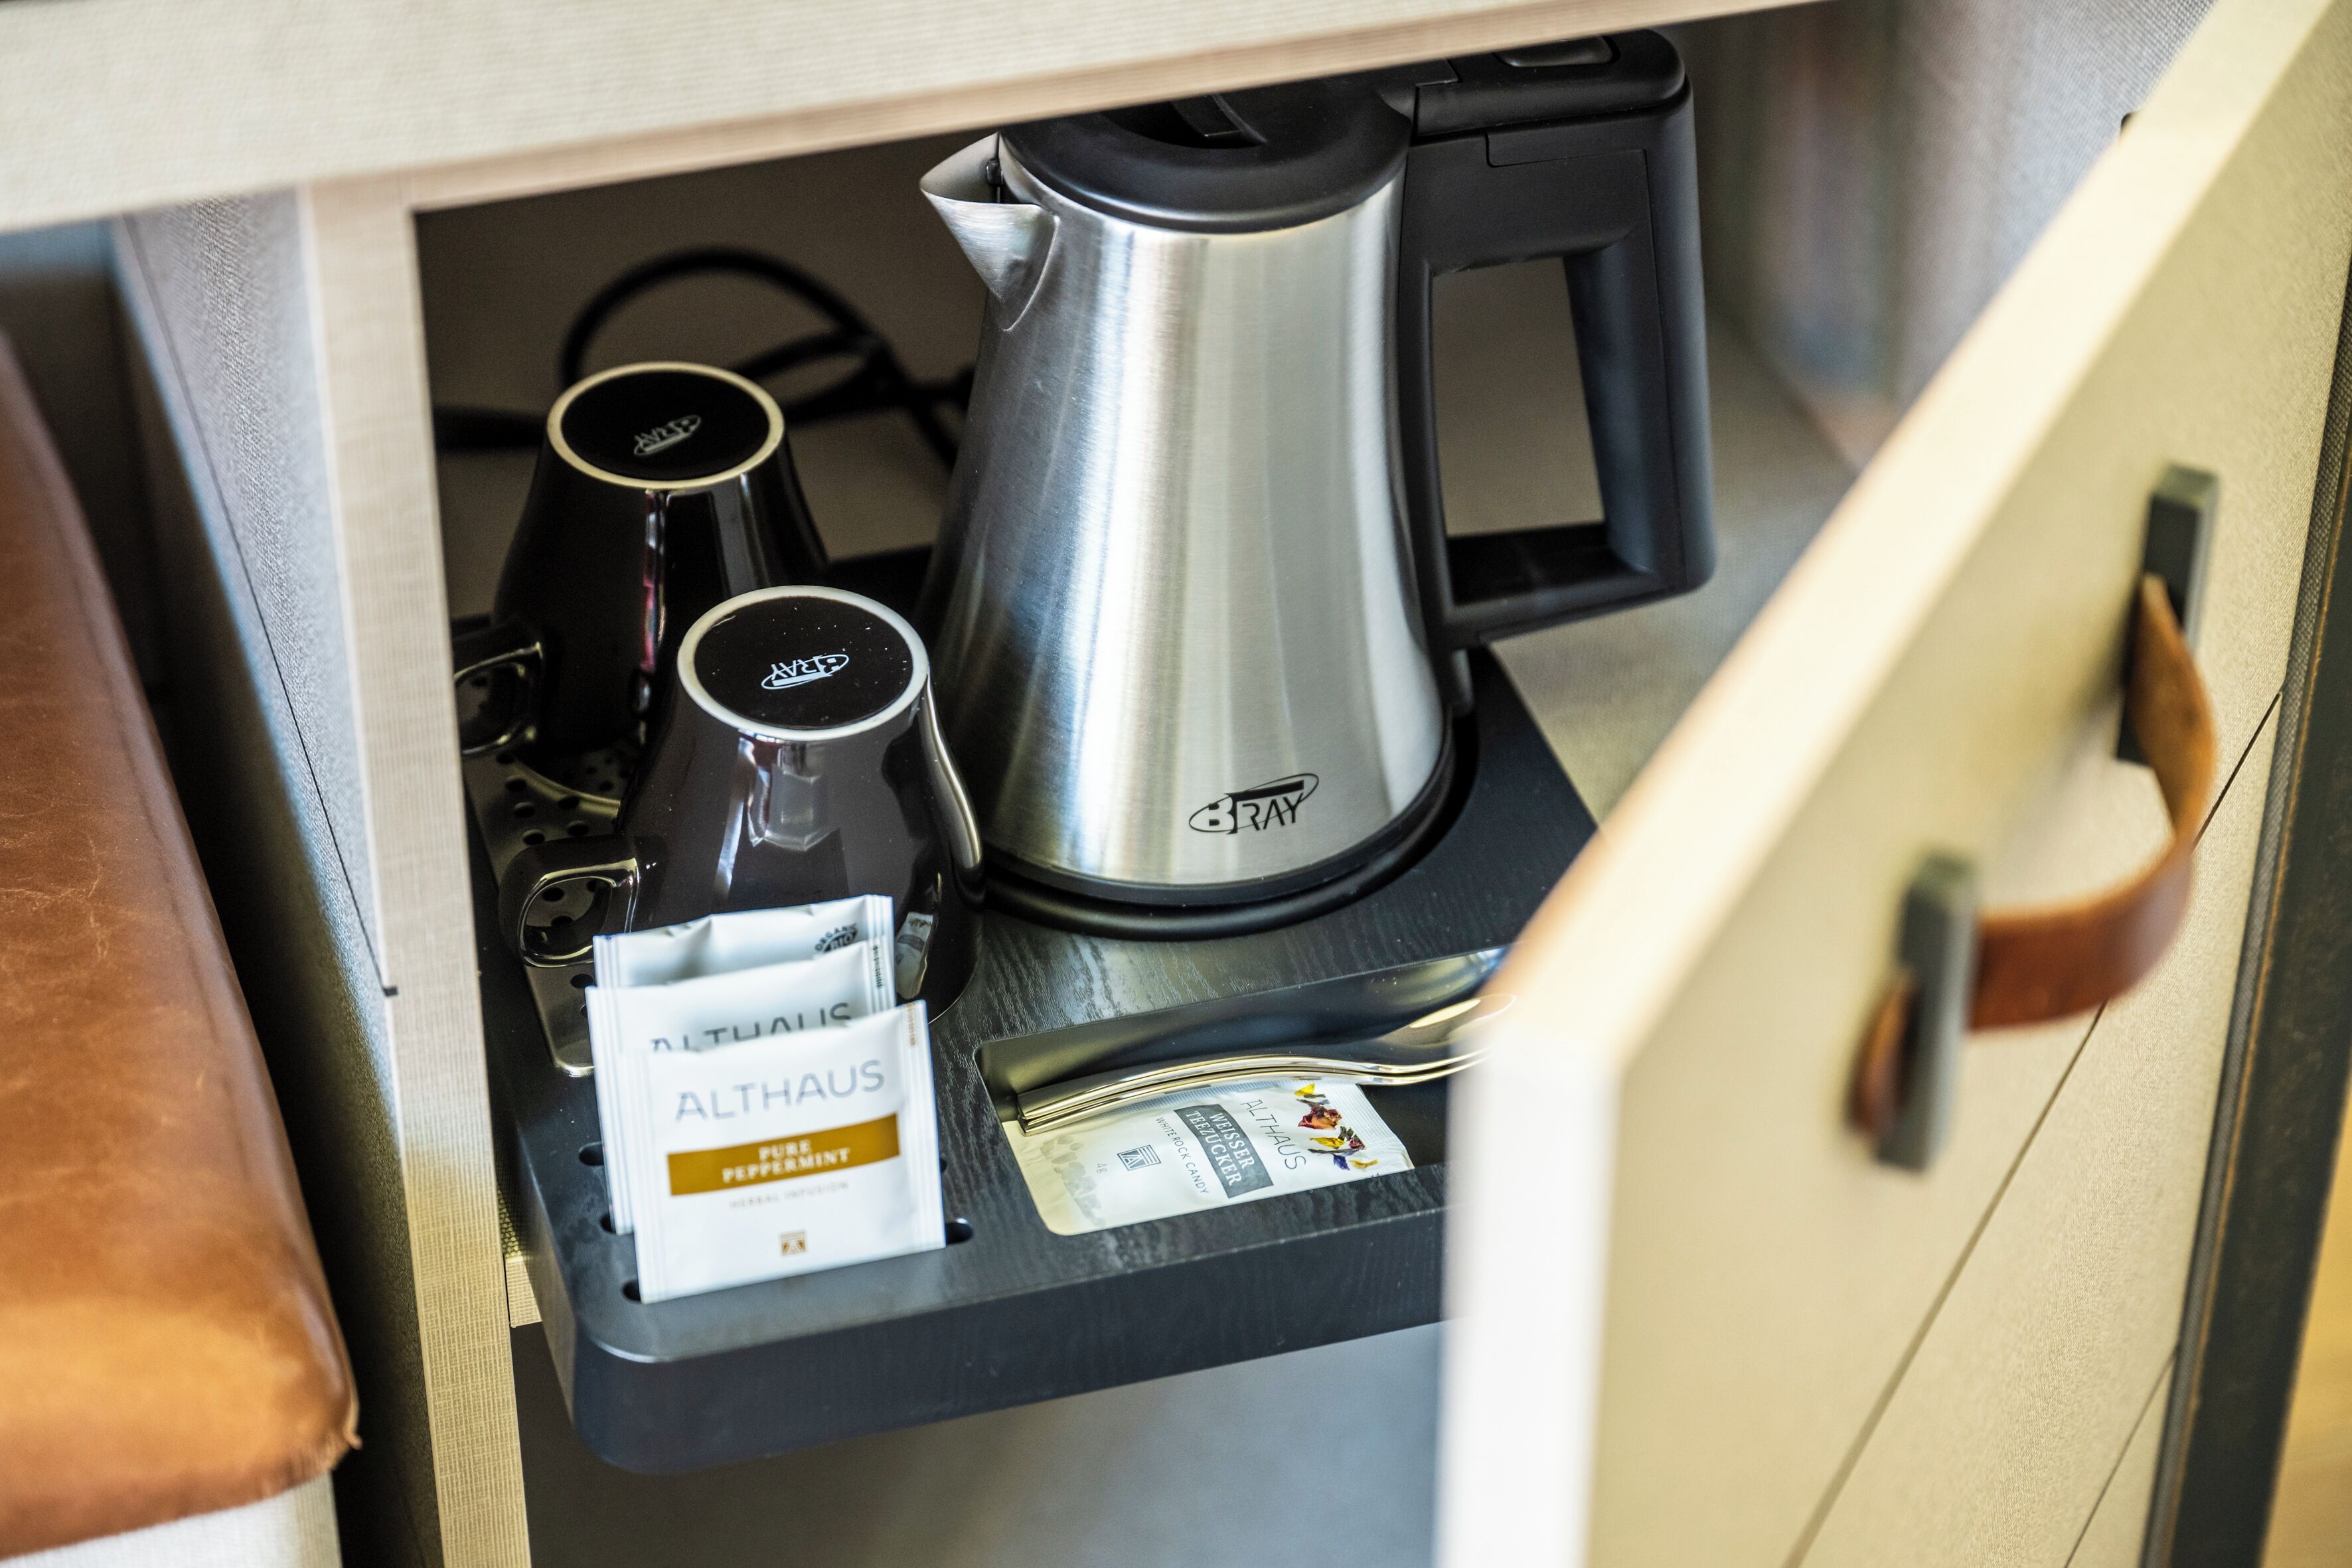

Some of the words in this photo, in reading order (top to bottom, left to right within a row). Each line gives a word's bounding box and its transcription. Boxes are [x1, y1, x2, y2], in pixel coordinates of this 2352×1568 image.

[1193, 777, 1309, 834] BRAY
[675, 1059, 885, 1121] ALTHAUS
[758, 1138, 811, 1161] PURE
[1185, 1111, 1243, 1186] TEEZUCKER
[1209, 1112, 1255, 1169] WEISSER
[1241, 1099, 1306, 1170] ALTHAUS
[722, 1146, 850, 1184] PEPPERMINT
[1186, 1162, 1210, 1194] CANDY
